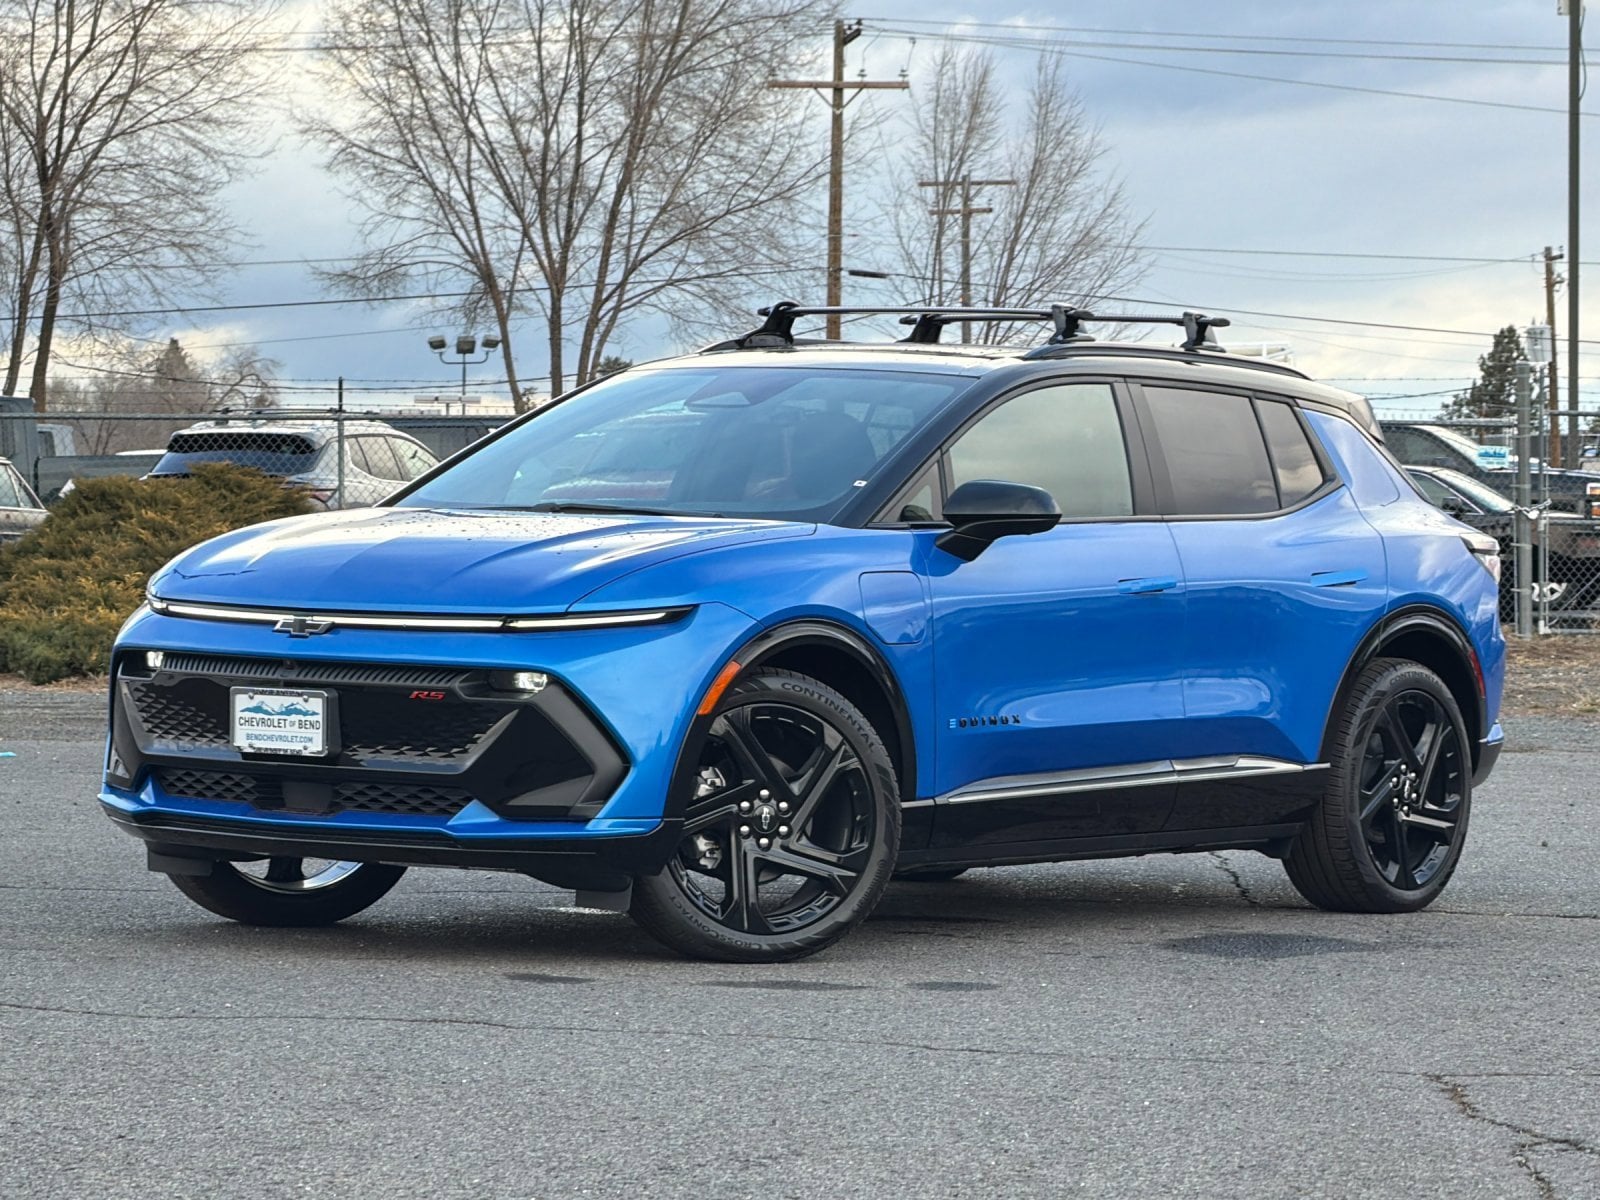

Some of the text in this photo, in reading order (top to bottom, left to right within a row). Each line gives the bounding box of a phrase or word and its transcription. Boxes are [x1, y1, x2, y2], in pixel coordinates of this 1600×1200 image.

[408, 690, 446, 700] RS
[781, 682, 874, 749] CONTINENTAL
[238, 716, 321, 730] CHEVROLET OF BEND
[246, 732, 314, 744] BENDCHEVROLET.COM
